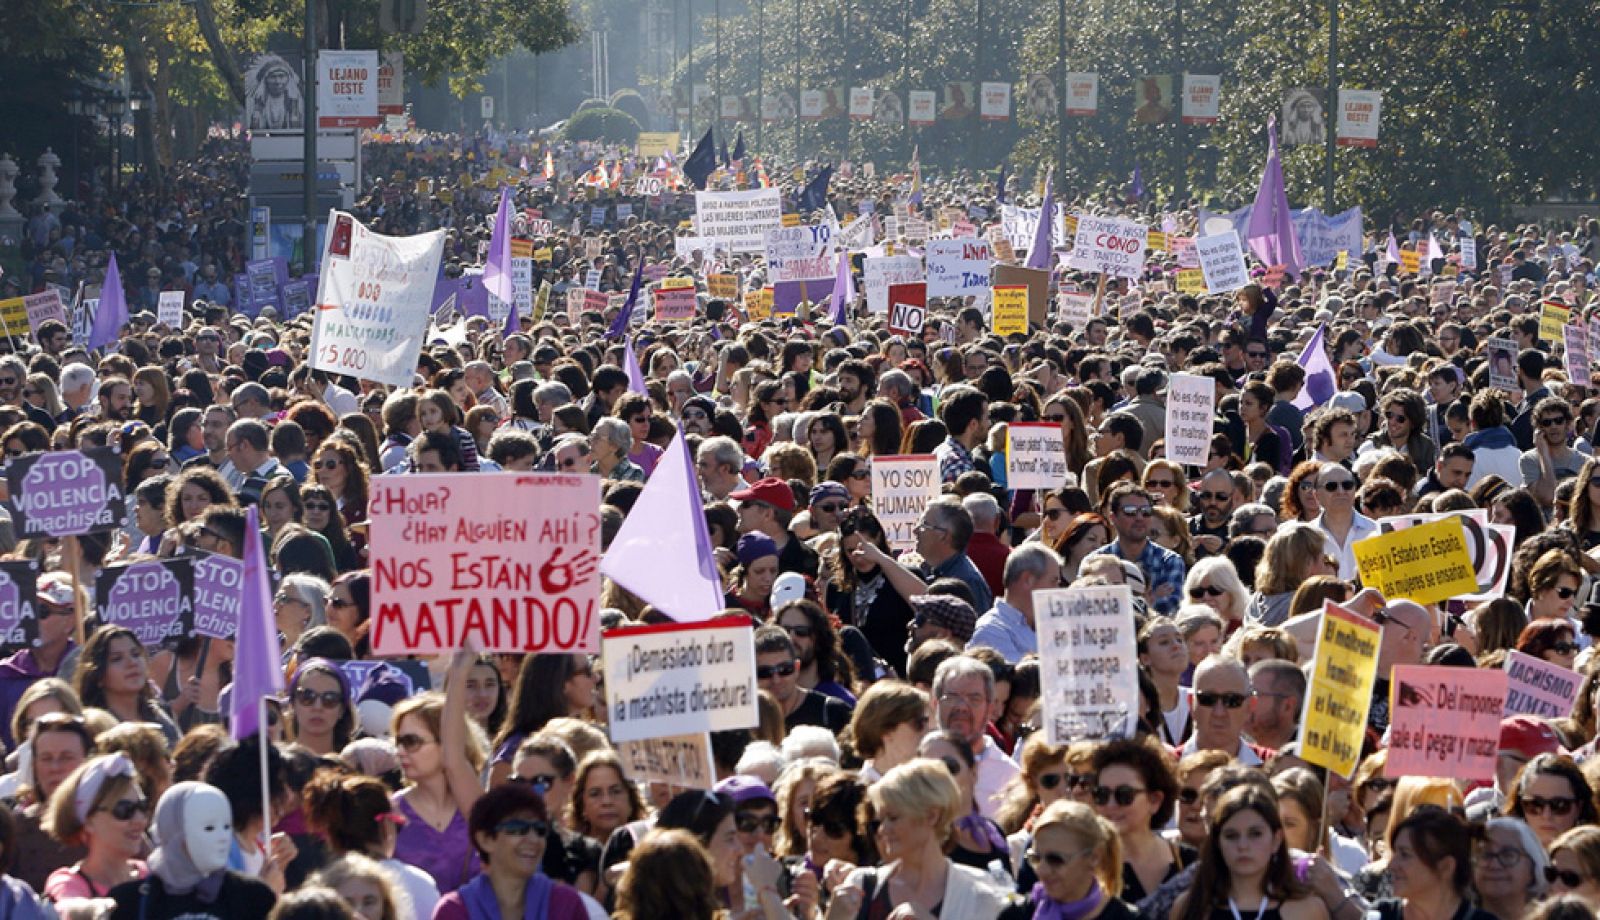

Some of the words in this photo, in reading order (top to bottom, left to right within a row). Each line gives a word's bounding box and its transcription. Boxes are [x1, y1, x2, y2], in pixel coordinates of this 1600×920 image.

[329, 67, 368, 80] LEJANO
[333, 83, 364, 94] OESTE
[714, 211, 744, 221] MUJERES
[716, 225, 748, 236] MUJERES
[810, 225, 830, 243] YO
[1077, 233, 1090, 246] EL
[1075, 247, 1087, 259] DE
[1093, 250, 1129, 264] TANTOS
[892, 305, 922, 329] NO
[29, 458, 96, 483] STOP
[879, 469, 900, 487] YO
[904, 469, 932, 487] SOY
[12, 482, 122, 512] VIOLENCIA
[876, 496, 931, 514] HUMAN
[25, 508, 114, 533] machista
[1391, 543, 1420, 568] Estado
[1421, 546, 1430, 559] en
[116, 569, 174, 594] STOP
[195, 560, 244, 590] STO
[374, 556, 433, 593] NOS
[450, 552, 532, 591] ESTÁN
[1395, 575, 1426, 597] mujeres
[1426, 575, 1436, 588] se
[98, 594, 192, 622] VIOLENCIA
[1049, 596, 1063, 617] La
[1067, 592, 1120, 617] violencia
[134, 620, 184, 641] chista
[372, 596, 593, 652] MATANDO!
[1054, 630, 1067, 647] en
[1071, 623, 1081, 646] el
[1084, 626, 1118, 650] hogar
[1325, 619, 1336, 642] El
[1335, 628, 1375, 658] maltrato
[627, 638, 702, 682] ¡Demasiado
[707, 635, 734, 664] dura
[1073, 657, 1121, 679] propaga
[614, 692, 626, 721] la
[629, 685, 686, 720] machista
[691, 677, 752, 713] dictadura!
[1437, 683, 1457, 709] Del
[1307, 729, 1320, 747] en
[1321, 729, 1332, 751] el
[1390, 724, 1412, 748] sale
[1413, 724, 1425, 749] el
[1426, 734, 1457, 761] pegar
[1458, 736, 1464, 763] y
